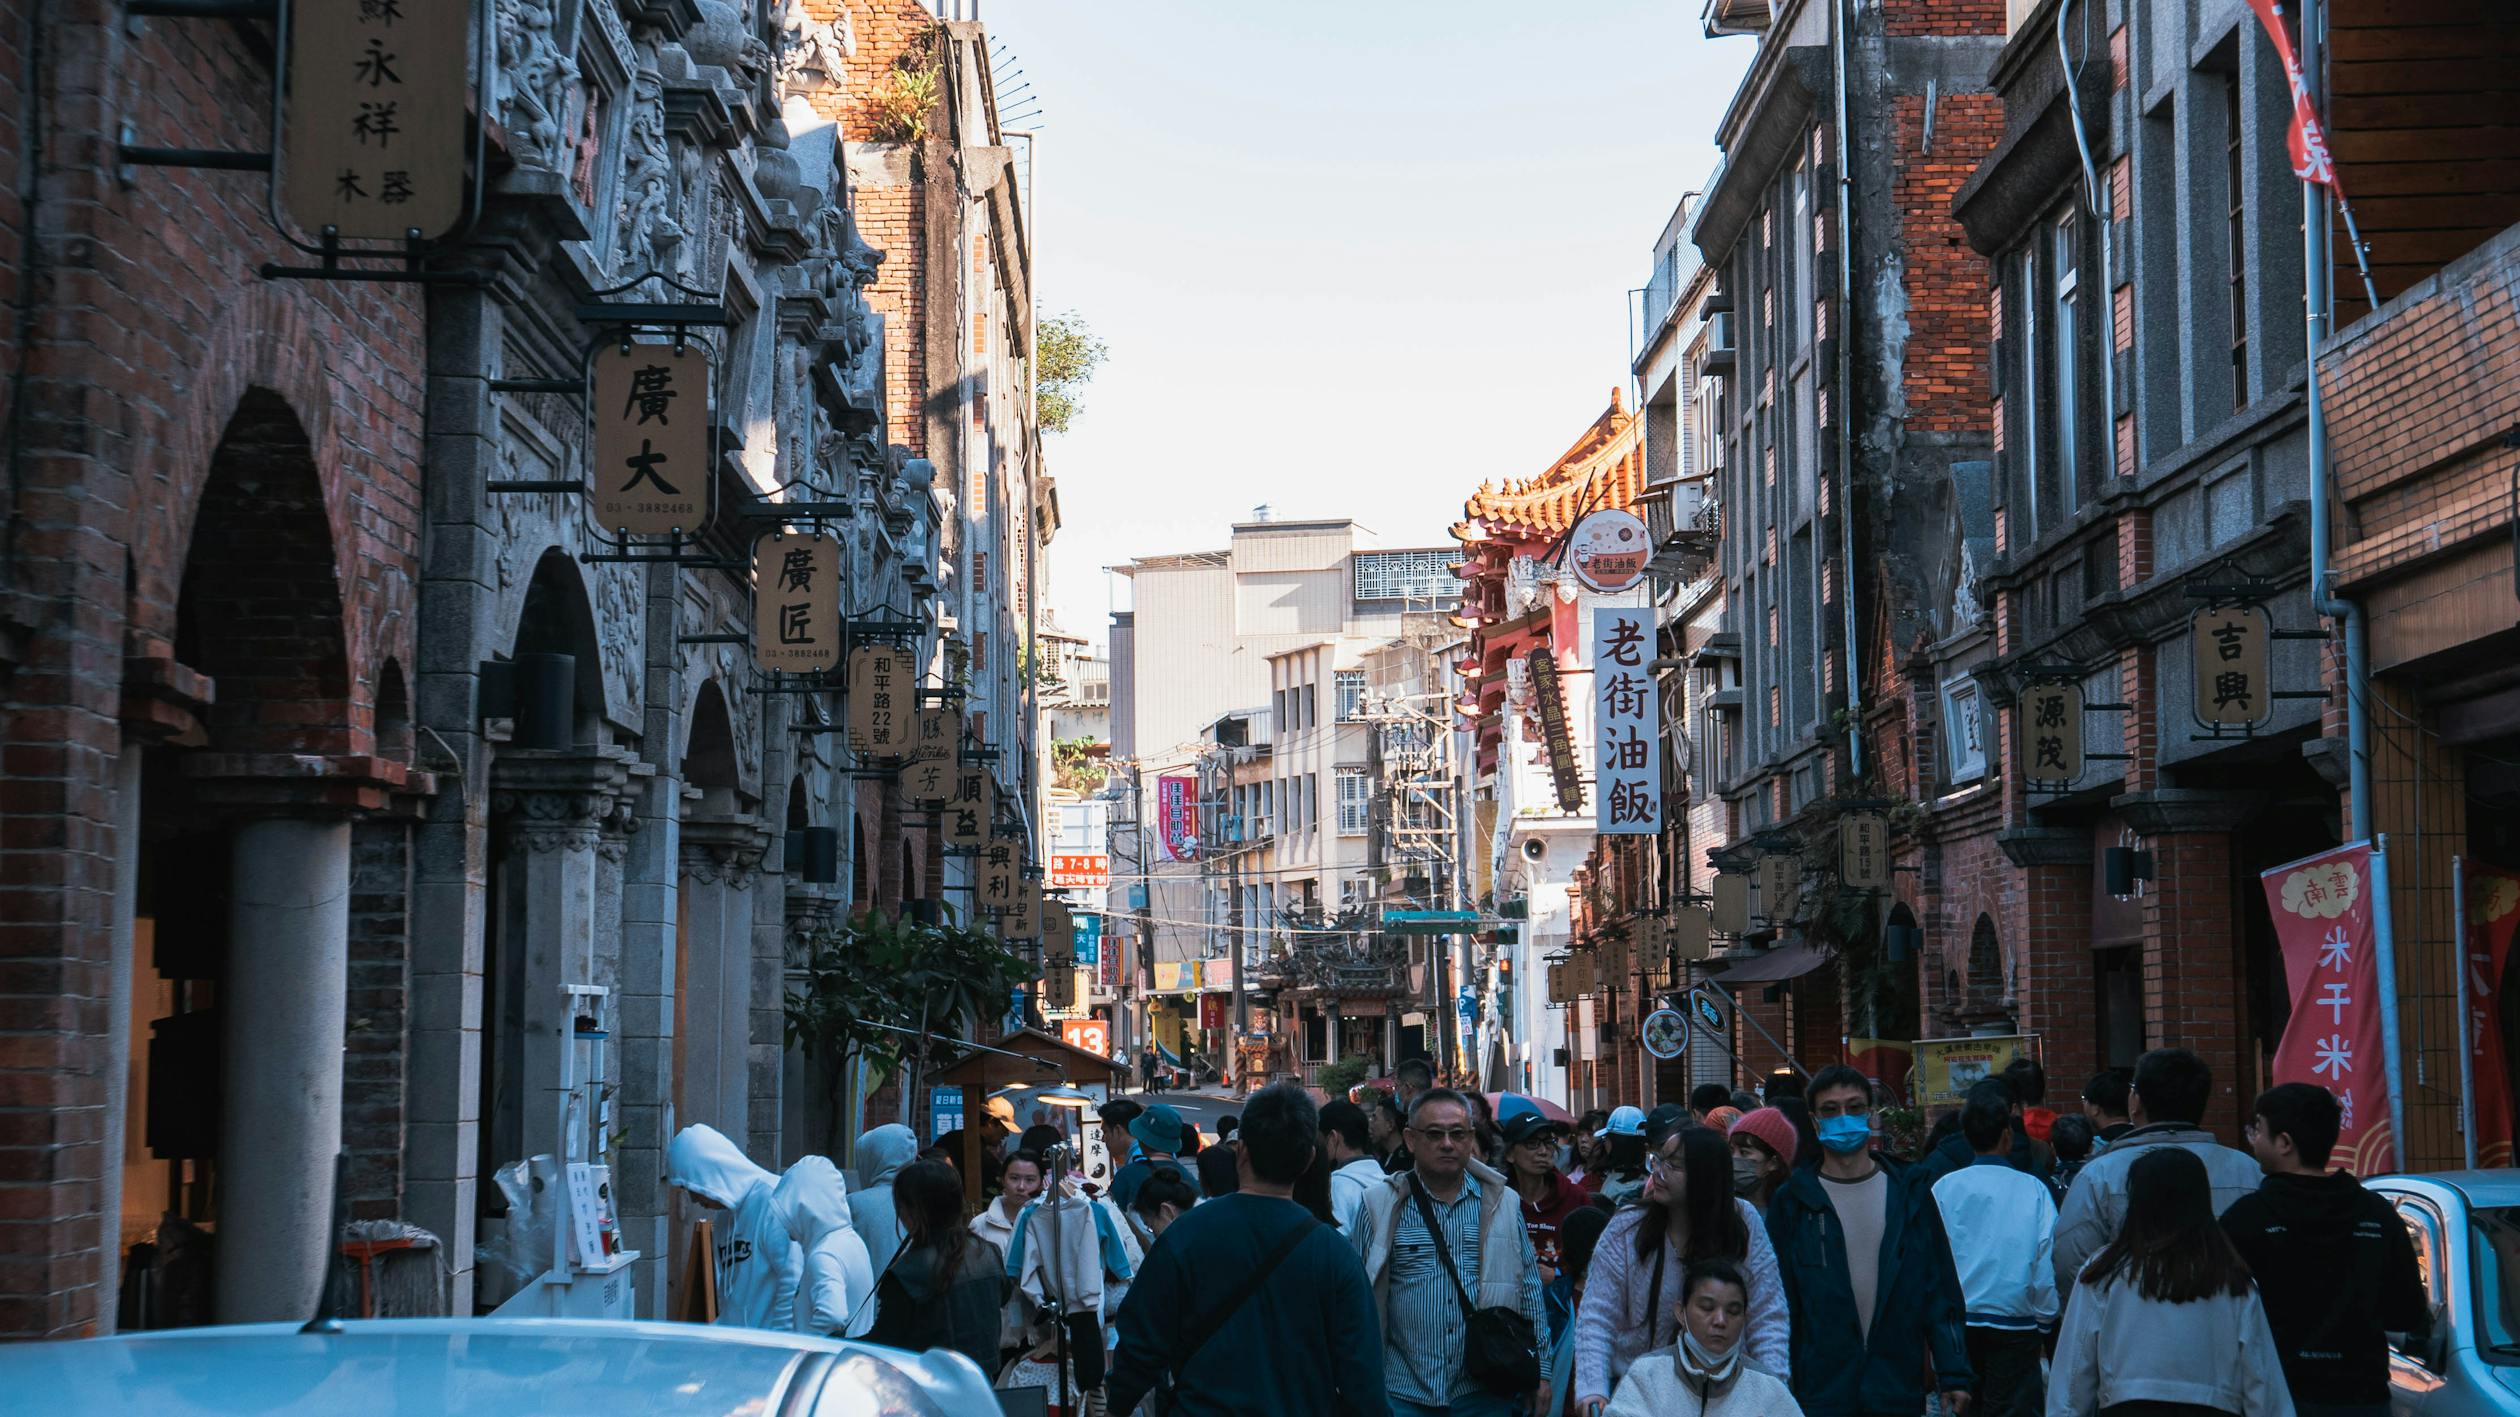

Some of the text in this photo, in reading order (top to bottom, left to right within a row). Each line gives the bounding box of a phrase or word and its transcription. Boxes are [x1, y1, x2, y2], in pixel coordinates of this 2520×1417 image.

[333, 168, 416, 204] 木器
[618, 364, 682, 495] 廣大
[777, 547, 818, 645] 廣匠
[1592, 556, 1637, 569] 老街油飯
[872, 656, 891, 745] 和平路22號
[2211, 621, 2253, 712] 吉興
[1602, 617, 1655, 825] 老街油飯
[2035, 694, 2067, 771] 源茂
[955, 775, 982, 837] 順益
[987, 846, 1011, 899] 興利
[1859, 823, 1871, 879] 和平路15號
[1067, 1027, 1104, 1055] 13
